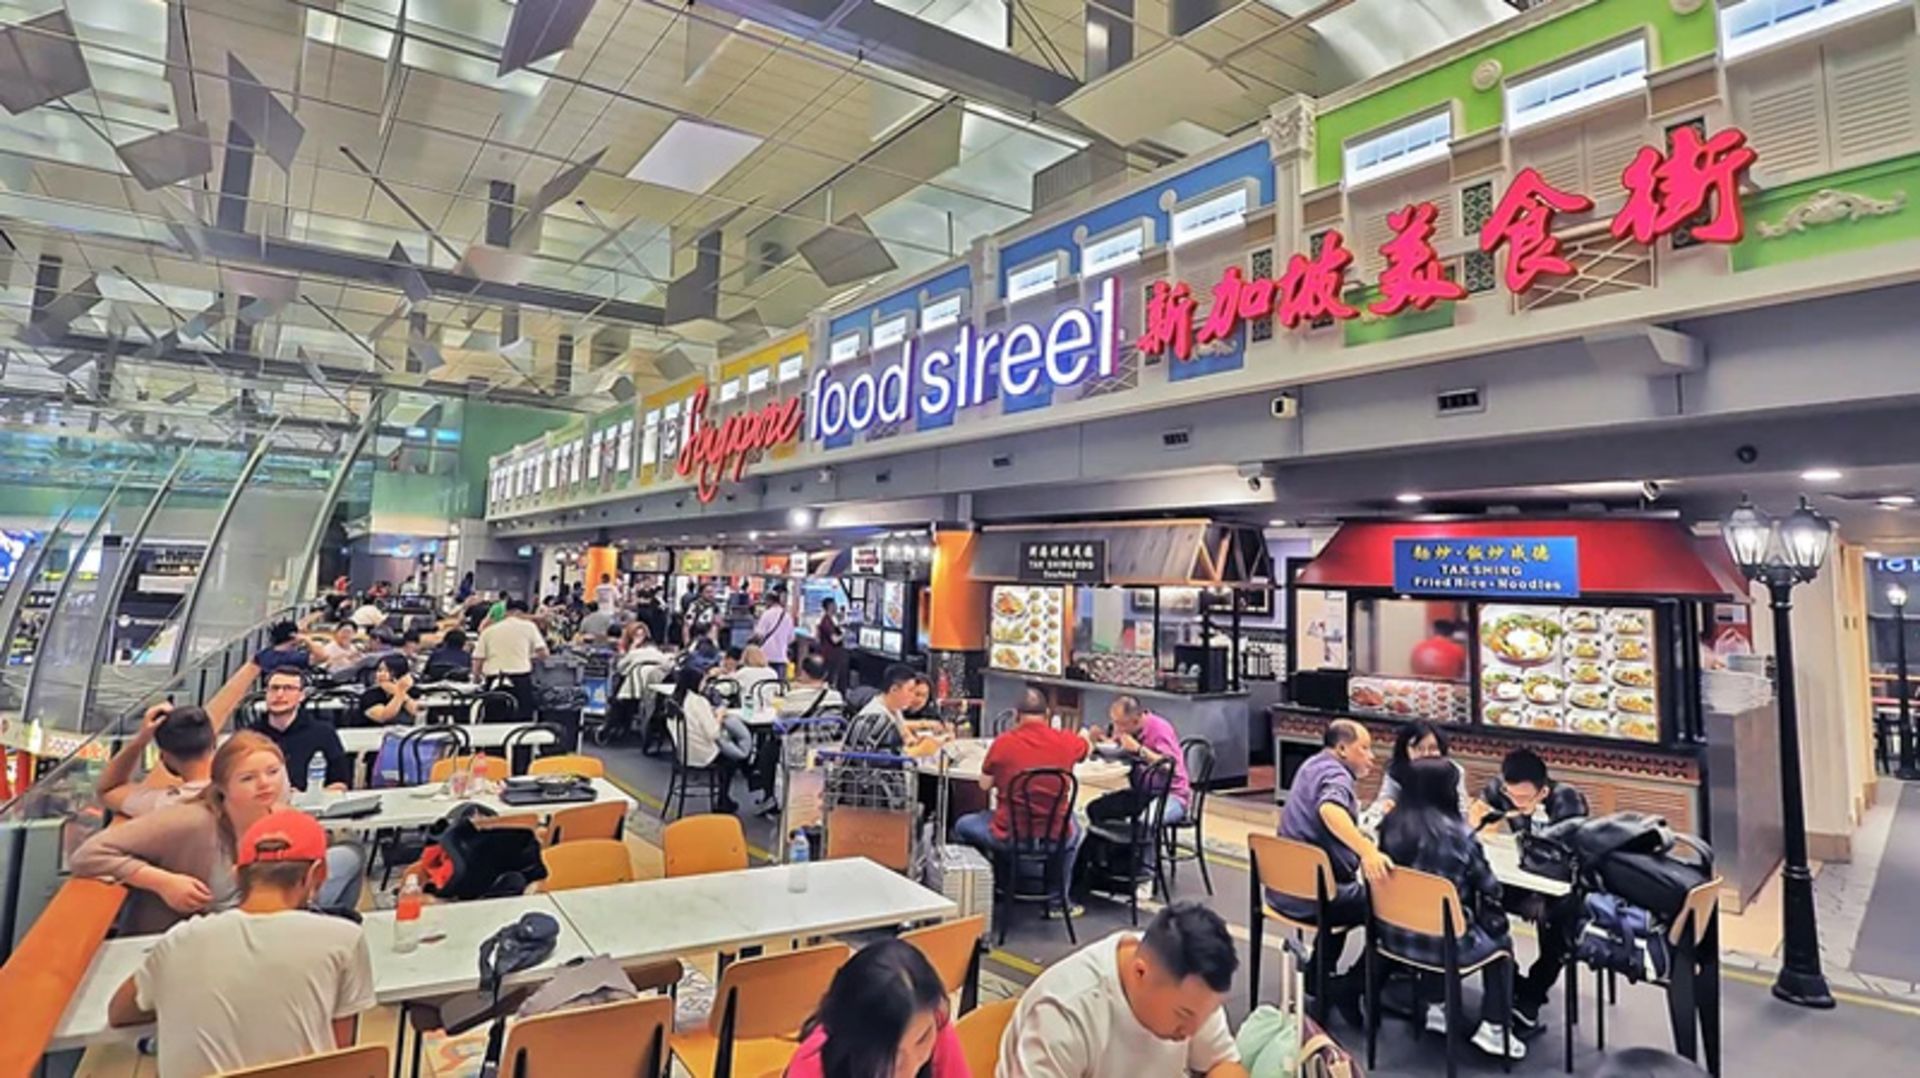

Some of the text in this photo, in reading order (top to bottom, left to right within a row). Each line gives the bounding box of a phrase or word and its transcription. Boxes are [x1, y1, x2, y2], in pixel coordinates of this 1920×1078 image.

[1137, 126, 1758, 362] 新加坡美食街
[676, 278, 1119, 502] Singapore food street
[1413, 577, 1562, 591] Fried Rice Noodles
[1440, 564, 1523, 577] TAK SHING
